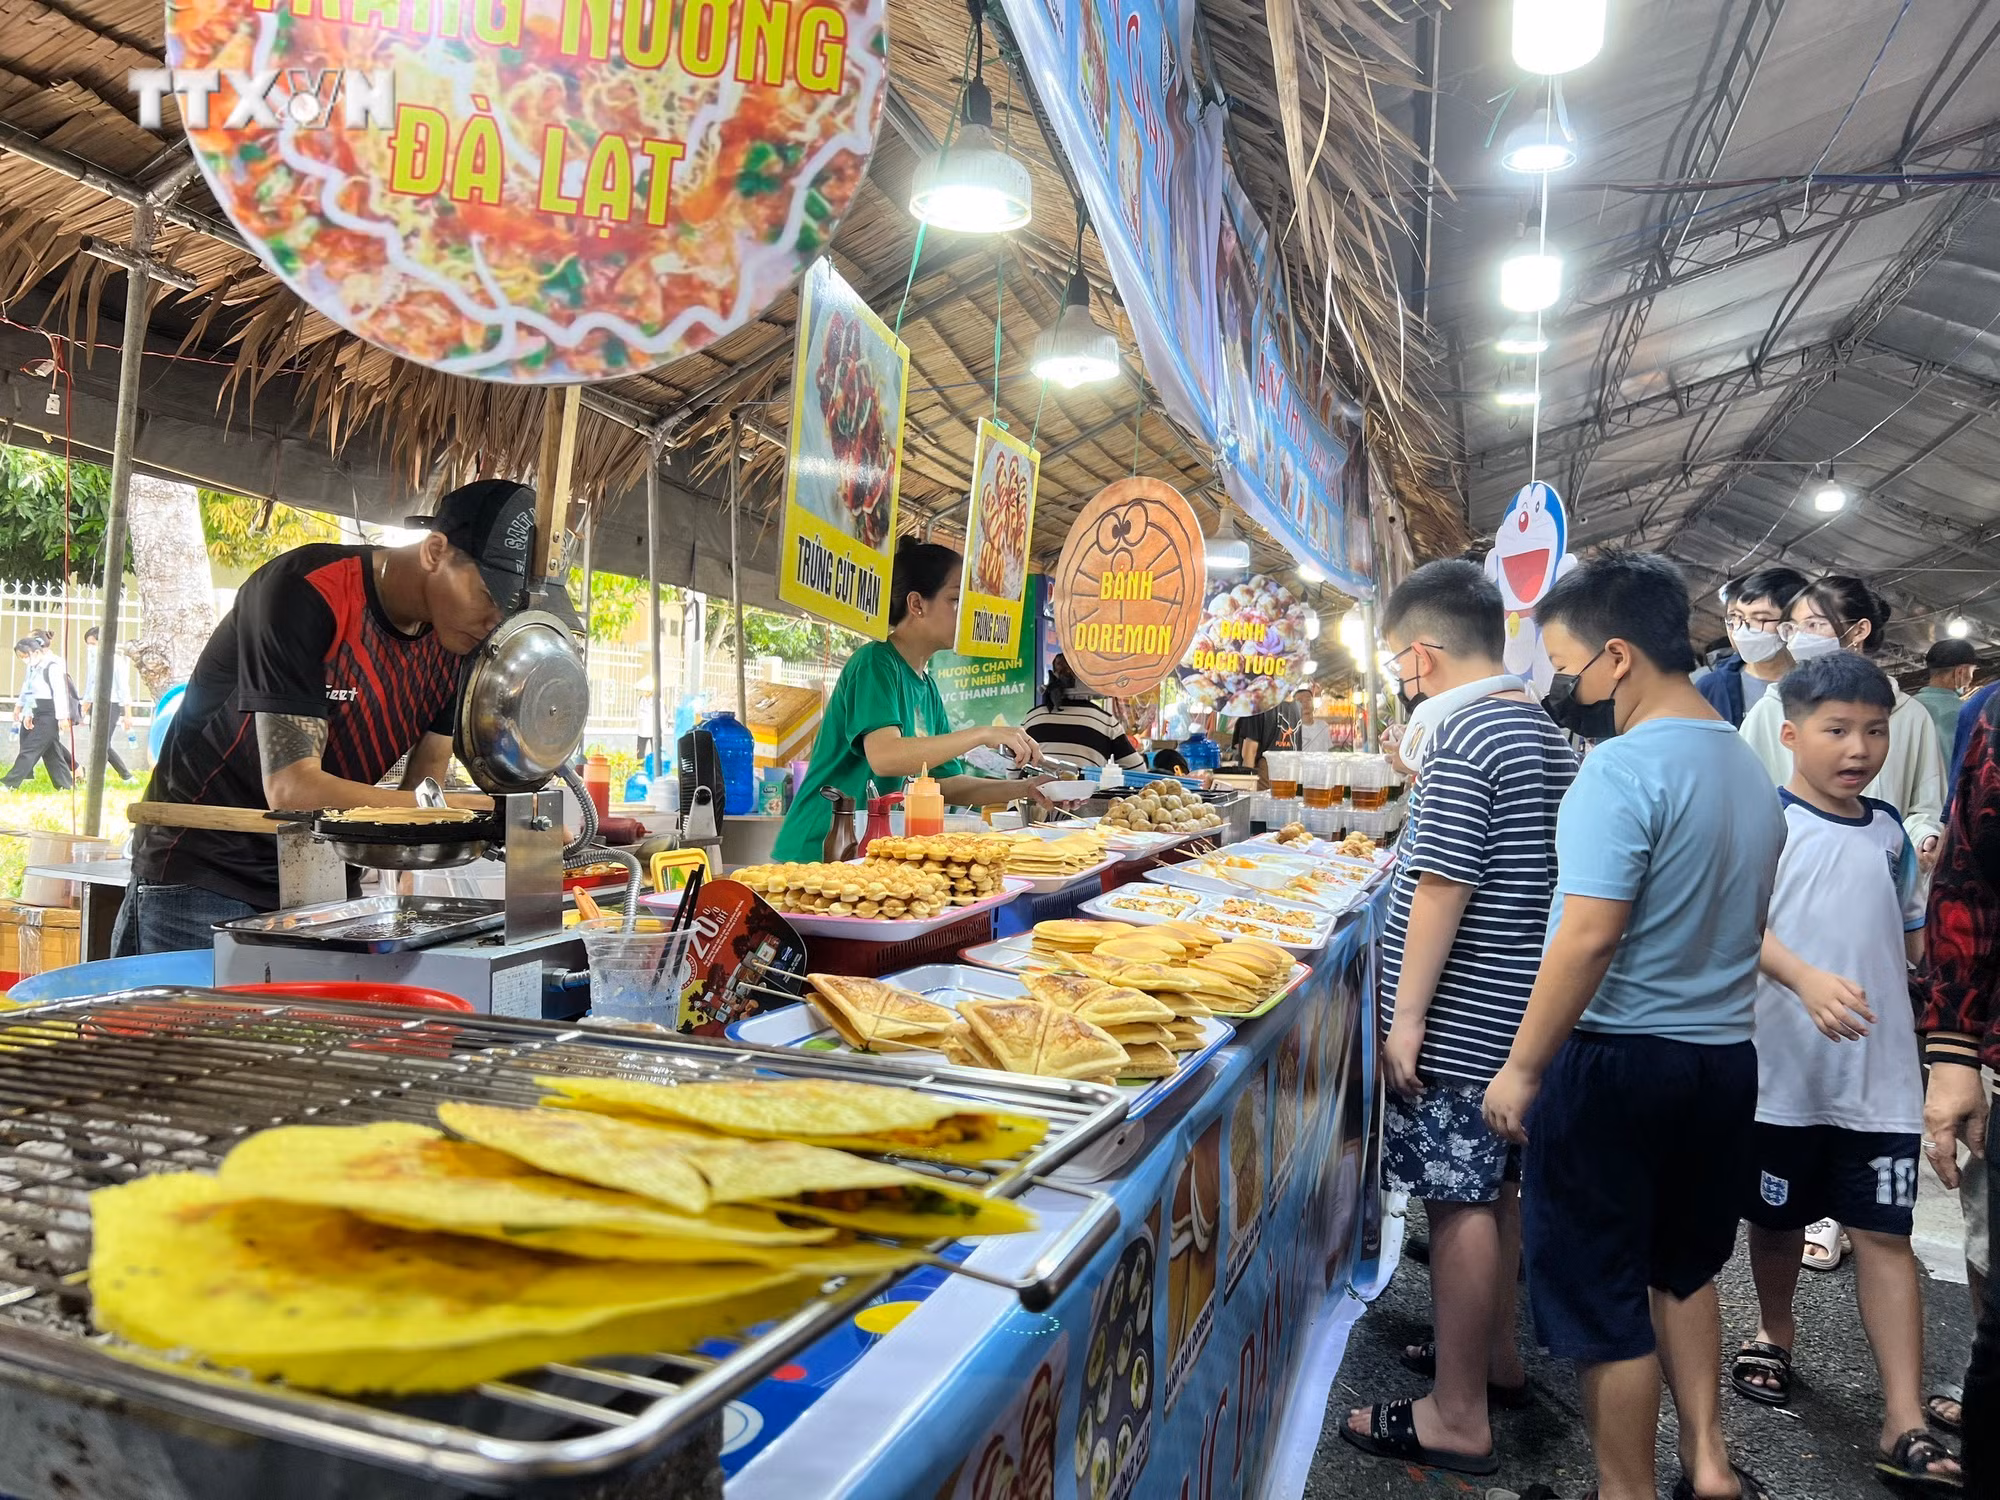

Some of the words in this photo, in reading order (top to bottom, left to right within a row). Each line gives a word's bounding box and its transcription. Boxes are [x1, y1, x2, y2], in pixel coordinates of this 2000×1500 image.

[388, 94, 504, 206] ĐÀ
[537, 123, 687, 239] LẠT
[797, 534, 834, 597] TRỨNG
[834, 551, 857, 606] CÚT
[856, 565, 881, 623] MẶN
[1100, 564, 1153, 601] BÁNH
[1074, 622, 1173, 656] DOREMON
[938, 664, 980, 679] HƯƠNG
[982, 658, 1022, 673] CHANH
[954, 679, 968, 690] TỰ
[971, 671, 1006, 686] NHIÊN
[960, 686, 998, 701] THANH
[1000, 681, 1026, 695] MÁT
[715, 909, 729, 924] OFF
